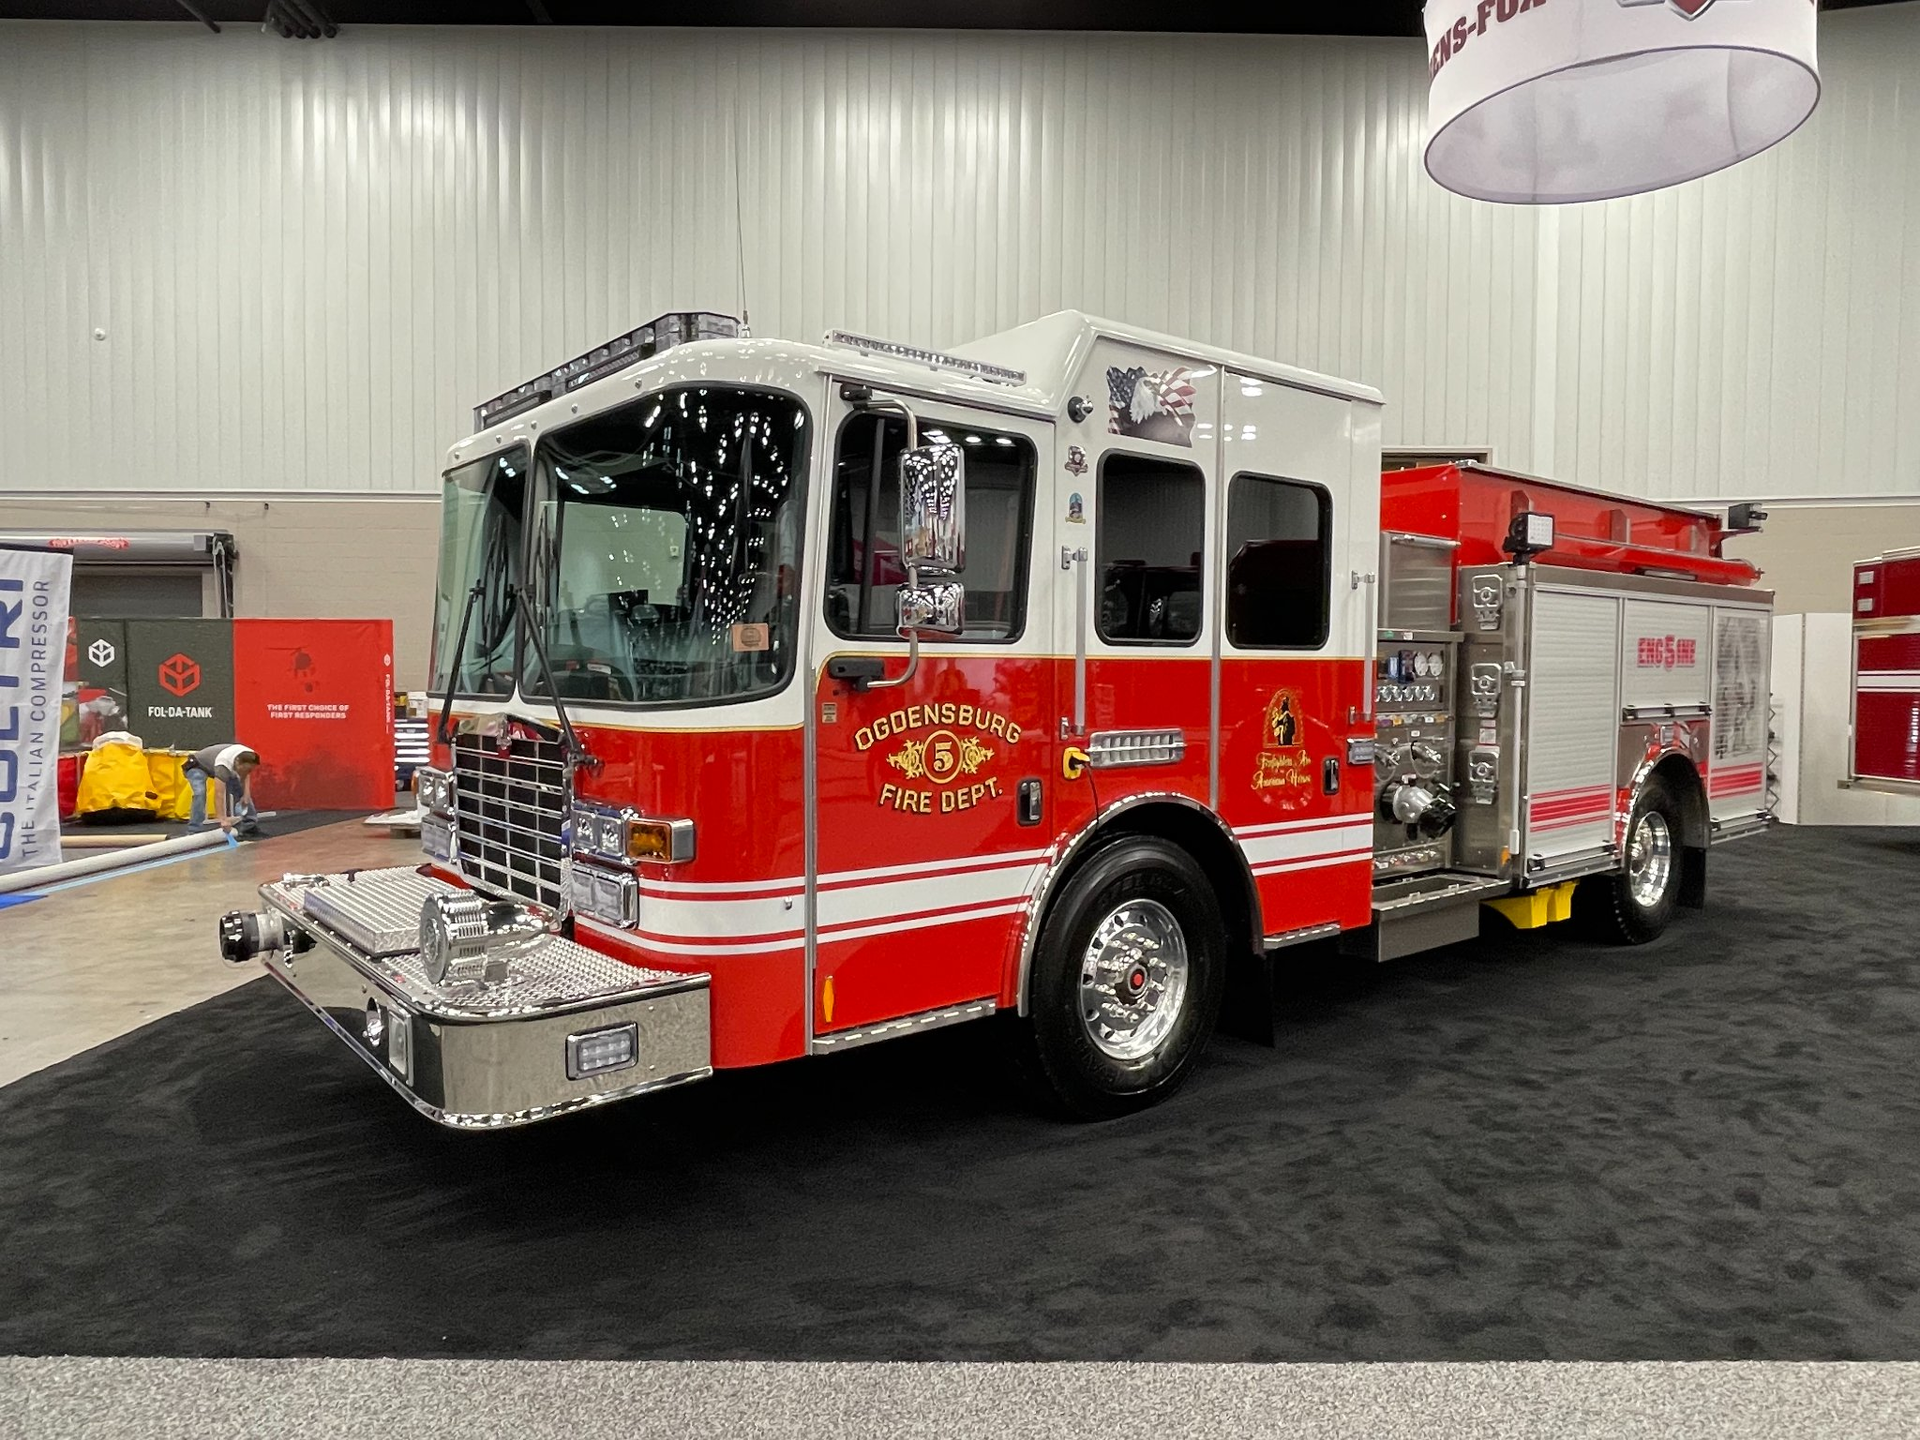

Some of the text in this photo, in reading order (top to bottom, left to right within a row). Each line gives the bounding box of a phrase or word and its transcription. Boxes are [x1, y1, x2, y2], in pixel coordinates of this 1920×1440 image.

[21, 581, 49, 857] THE ITALIAN COMPRESSOR
[148, 706, 212, 718] FOL-DA-TANK
[854, 703, 1022, 750] OGDENSBURG
[933, 742, 954, 771] 5
[879, 777, 1003, 813] FIRE DEPT.
